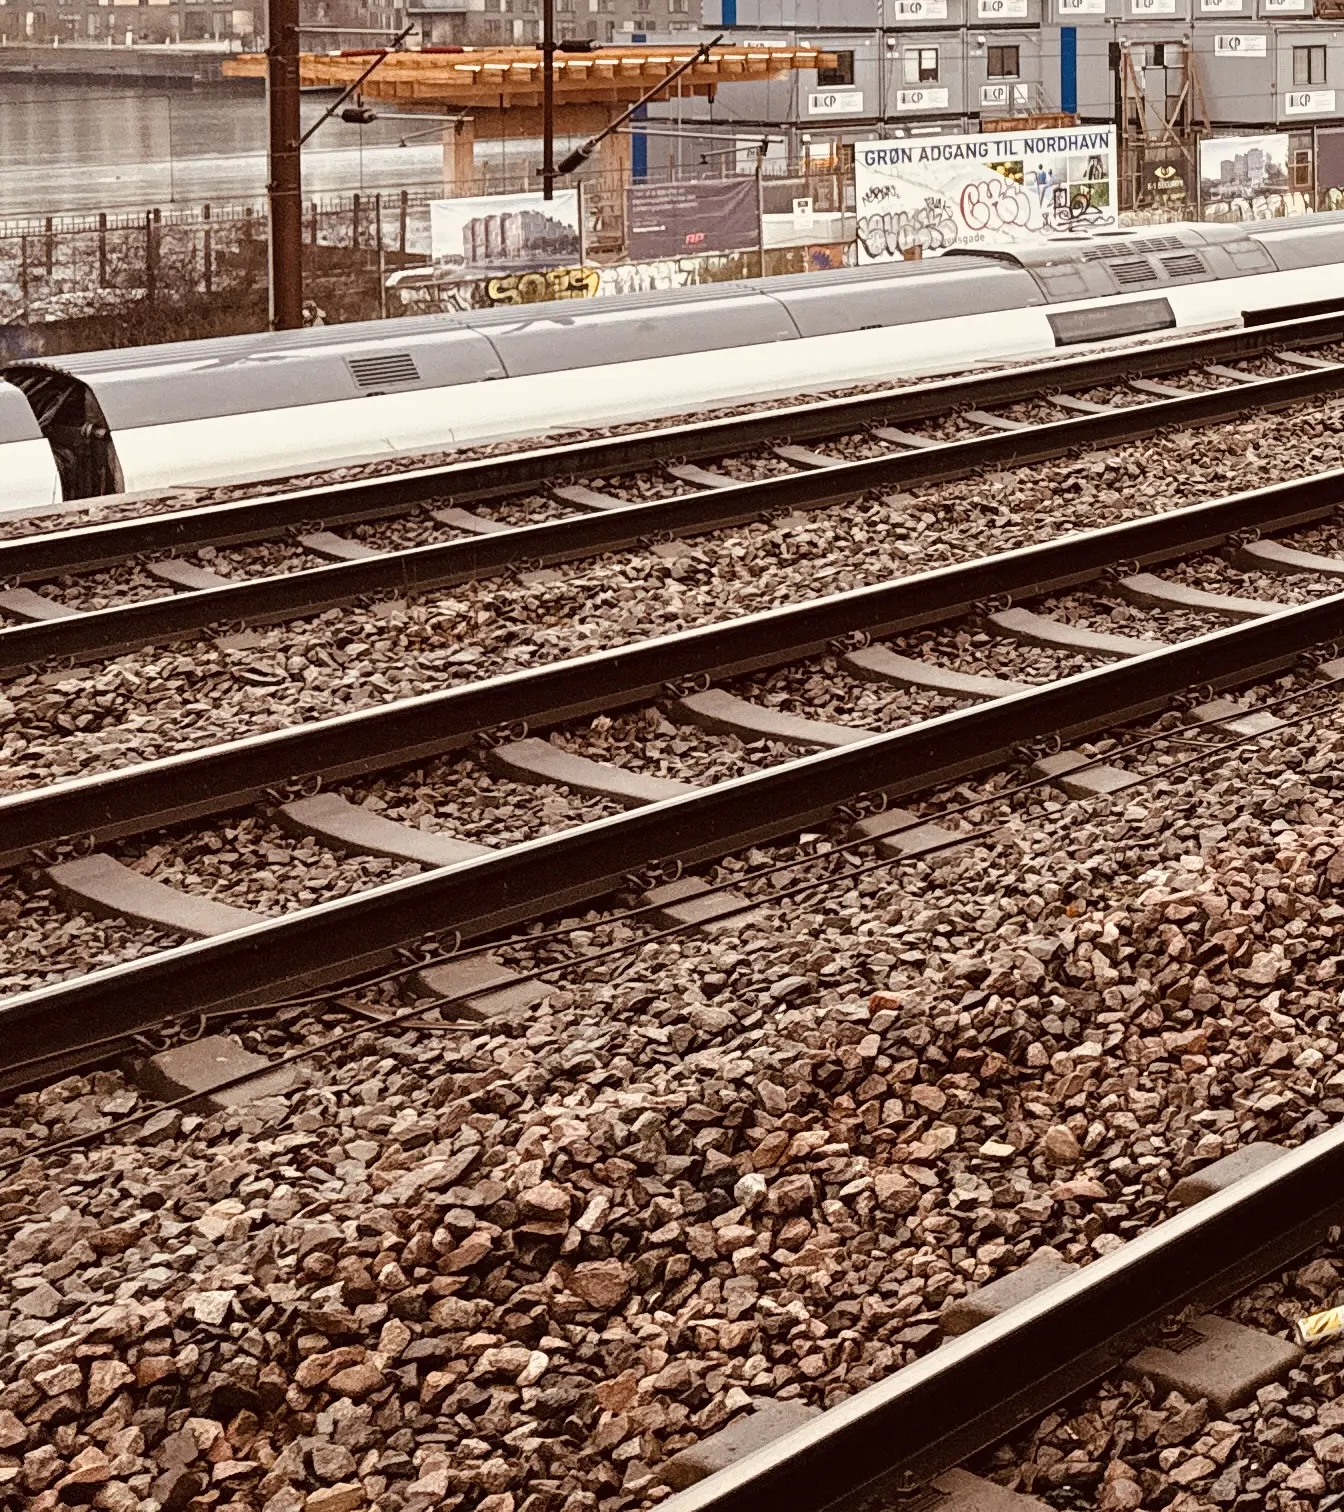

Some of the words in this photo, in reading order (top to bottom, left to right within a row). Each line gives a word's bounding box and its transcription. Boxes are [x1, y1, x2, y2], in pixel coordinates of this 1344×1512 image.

[865, 147, 912, 166] GRØN
[919, 142, 989, 163] ADGANG
[995, 140, 1018, 157] TIL
[1024, 133, 1109, 155] NORDHAVN
